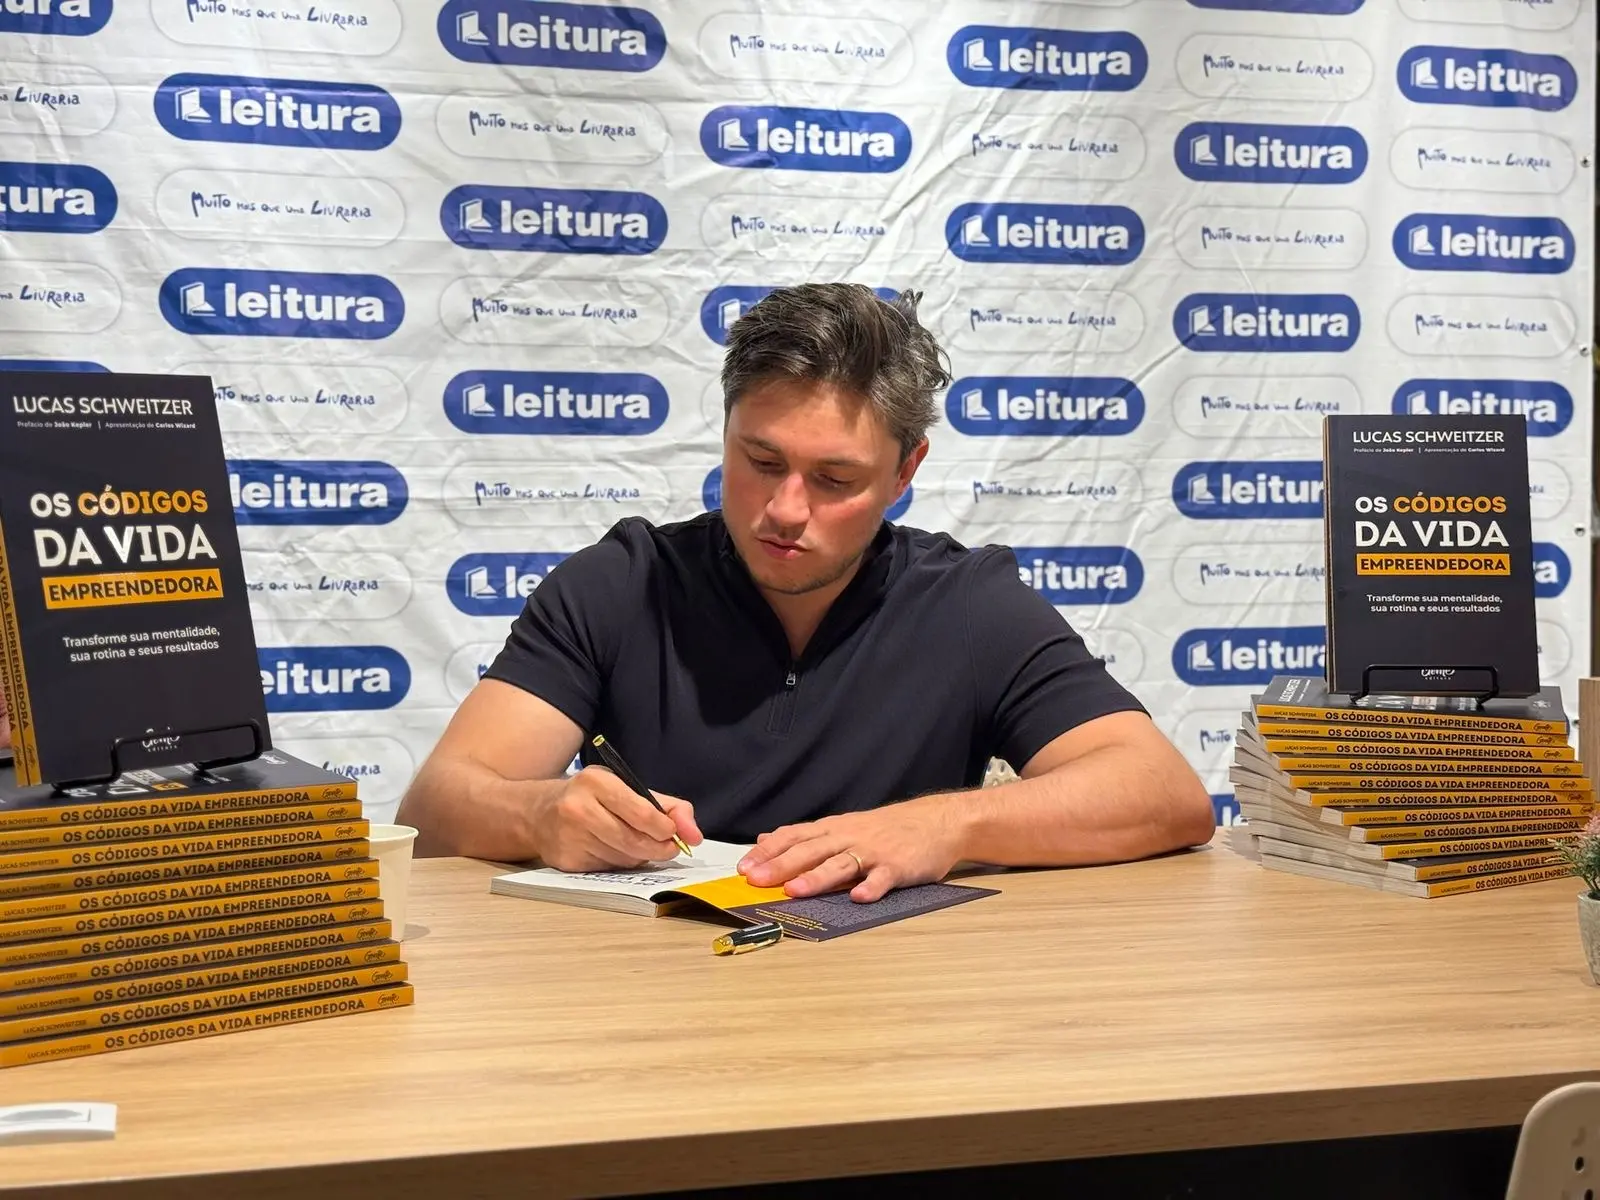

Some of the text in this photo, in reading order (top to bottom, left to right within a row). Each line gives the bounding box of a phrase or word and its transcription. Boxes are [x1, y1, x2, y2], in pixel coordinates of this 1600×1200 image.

[497, 12, 649, 57] leitura
[999, 39, 1132, 77] leitura
[1444, 58, 1562, 97] leitura
[219, 90, 382, 133] leitura
[756, 118, 895, 157] leitura
[1224, 134, 1353, 170] leitura
[500, 199, 650, 239] leitura
[997, 215, 1130, 250] leitura
[1441, 225, 1566, 260] leitura
[225, 283, 386, 323] leitura
[1222, 305, 1350, 337] leitura
[13, 396, 194, 415] LUCAS SCHWEITZER
[503, 384, 651, 420] leitura
[998, 388, 1129, 421] leitura
[1439, 391, 1557, 422] leitura
[1353, 431, 1504, 443] LUCAS SCHWEITZER
[30, 484, 208, 518] OS CÓDIGOS
[229, 474, 389, 509] leitura
[1221, 473, 1324, 505] leitur
[1355, 491, 1507, 514] OS CÓDIGOS
[34, 524, 218, 568] DA VIDA
[1355, 520, 1509, 548] DA VIDA
[1019, 559, 1128, 590] itura
[1360, 558, 1506, 571] EMPREENDEDORA
[49, 576, 219, 602] EMPREENDEDORA
[1367, 594, 1419, 603] Transforme
[1440, 594, 1502, 604] mentalidade,
[1389, 604, 1416, 613] rotina
[1450, 604, 1500, 613] resultados
[63, 626, 220, 649] Transforme sua mentalidade,
[70, 640, 219, 662] sua rotina e seus resultados
[261, 661, 391, 696] itura
[1324, 710, 1522, 730] OS CÓDIGOS DA VIDA EMPREENDEDORA
[1327, 726, 1525, 744] OS CÓDIGOS DA VIDA EMPREENDEDORA
[1336, 742, 1532, 758] OS CÓDIGOS DA VIDA EMPREENDEDORA
[1359, 776, 1549, 788] OS CÓDIGOS DA VIDA EMPREENDEDORA
[60, 790, 309, 822] OS CÓDIGOS DA VIDA EMPREENDEDORA
[1404, 808, 1570, 821] OS CÓDIGOS DA VIDA EMPREENDEDORA
[71, 829, 322, 865] OS CÓDIGOS DA VIDA EMPREENDEDORA
[79, 897, 98, 910] OS
[102, 890, 166, 907] CÓDIGOS
[170, 887, 188, 899] DA
[192, 883, 222, 897] VIDA
[225, 871, 331, 893] EMPREENDEDORA
[81, 911, 335, 954] OS CÓDIGOS DA VIDA EMPREENDEDORA
[93, 955, 351, 1001] OS CÓDIGOS DA VIDA EMPREENDEDORA
[104, 1036, 124, 1049] OS
[128, 1025, 195, 1045] CÓDIGOS
[198, 1021, 216, 1034] DA
[219, 1016, 251, 1031] VIDA
[254, 998, 364, 1025] EMPREENDEDORA
